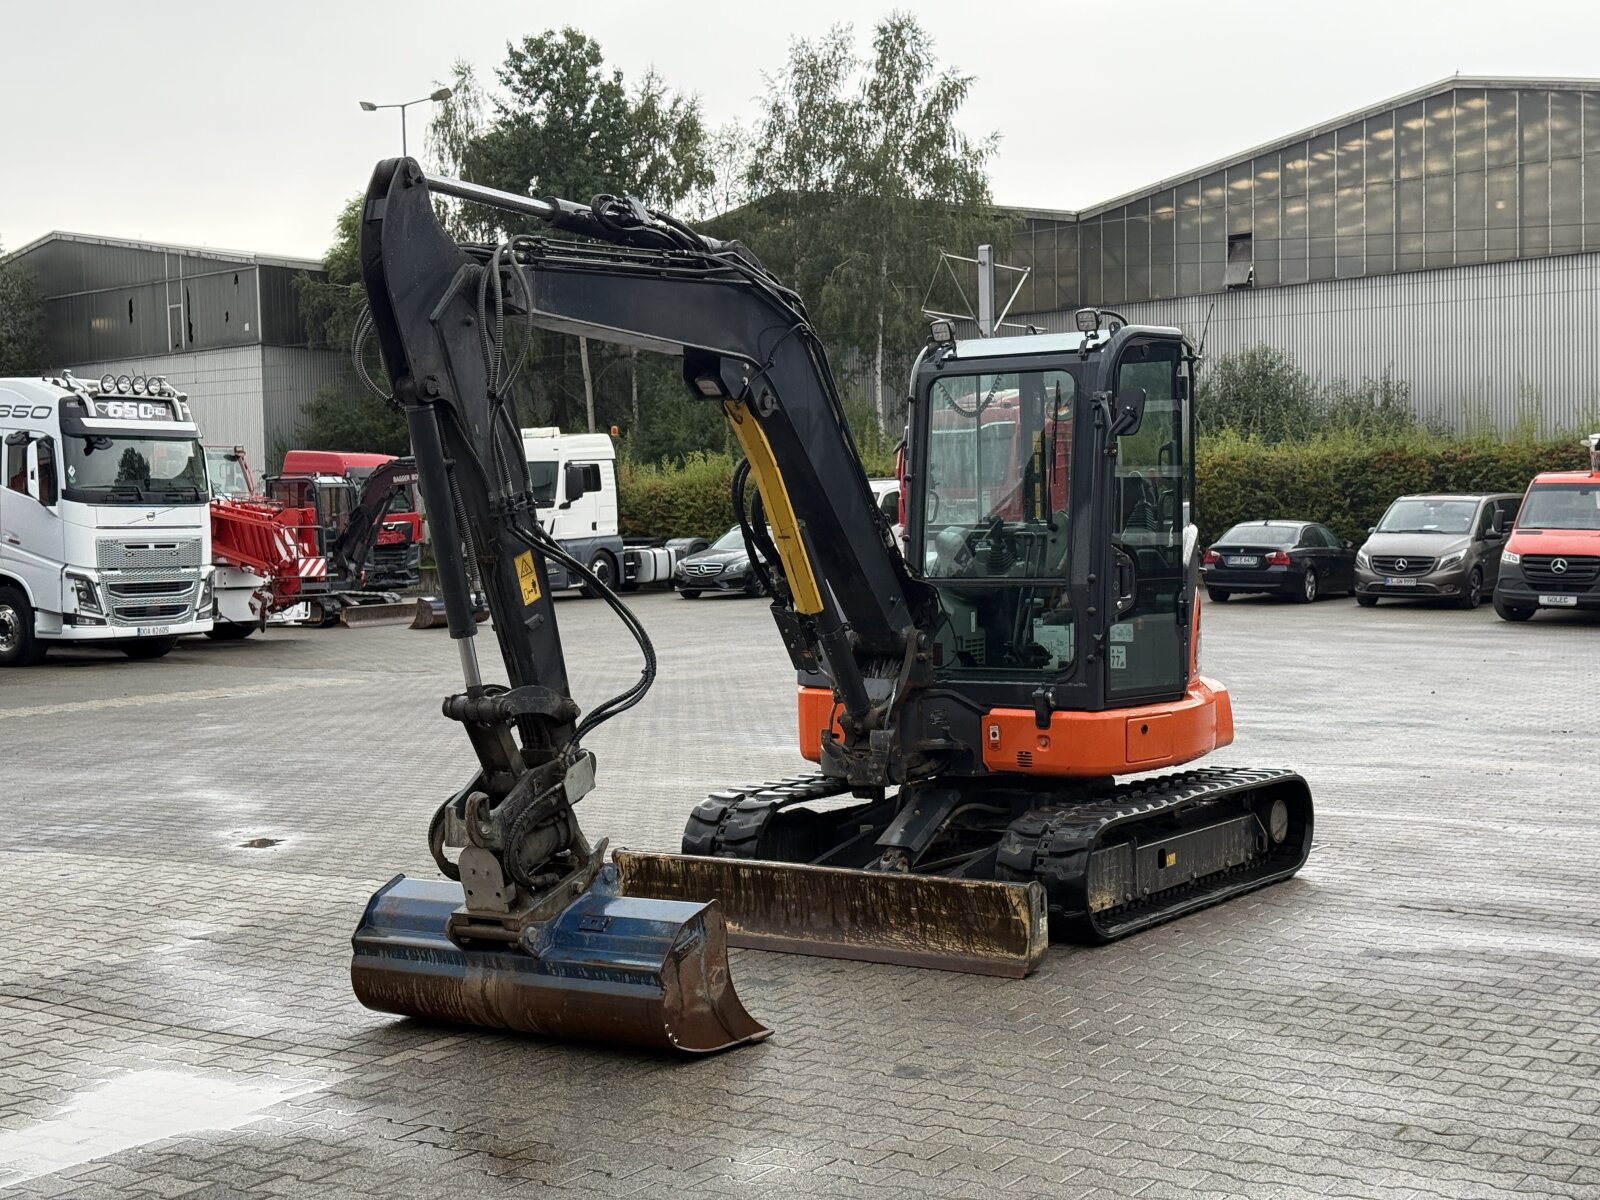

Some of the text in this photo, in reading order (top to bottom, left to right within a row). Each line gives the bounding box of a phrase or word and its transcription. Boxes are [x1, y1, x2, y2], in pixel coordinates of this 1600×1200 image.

[108, 402, 153, 419] 650
[393, 475, 410, 483] BAGGER
[1547, 596, 1569, 604] GOLEC
[1111, 655, 1120, 667] 77
